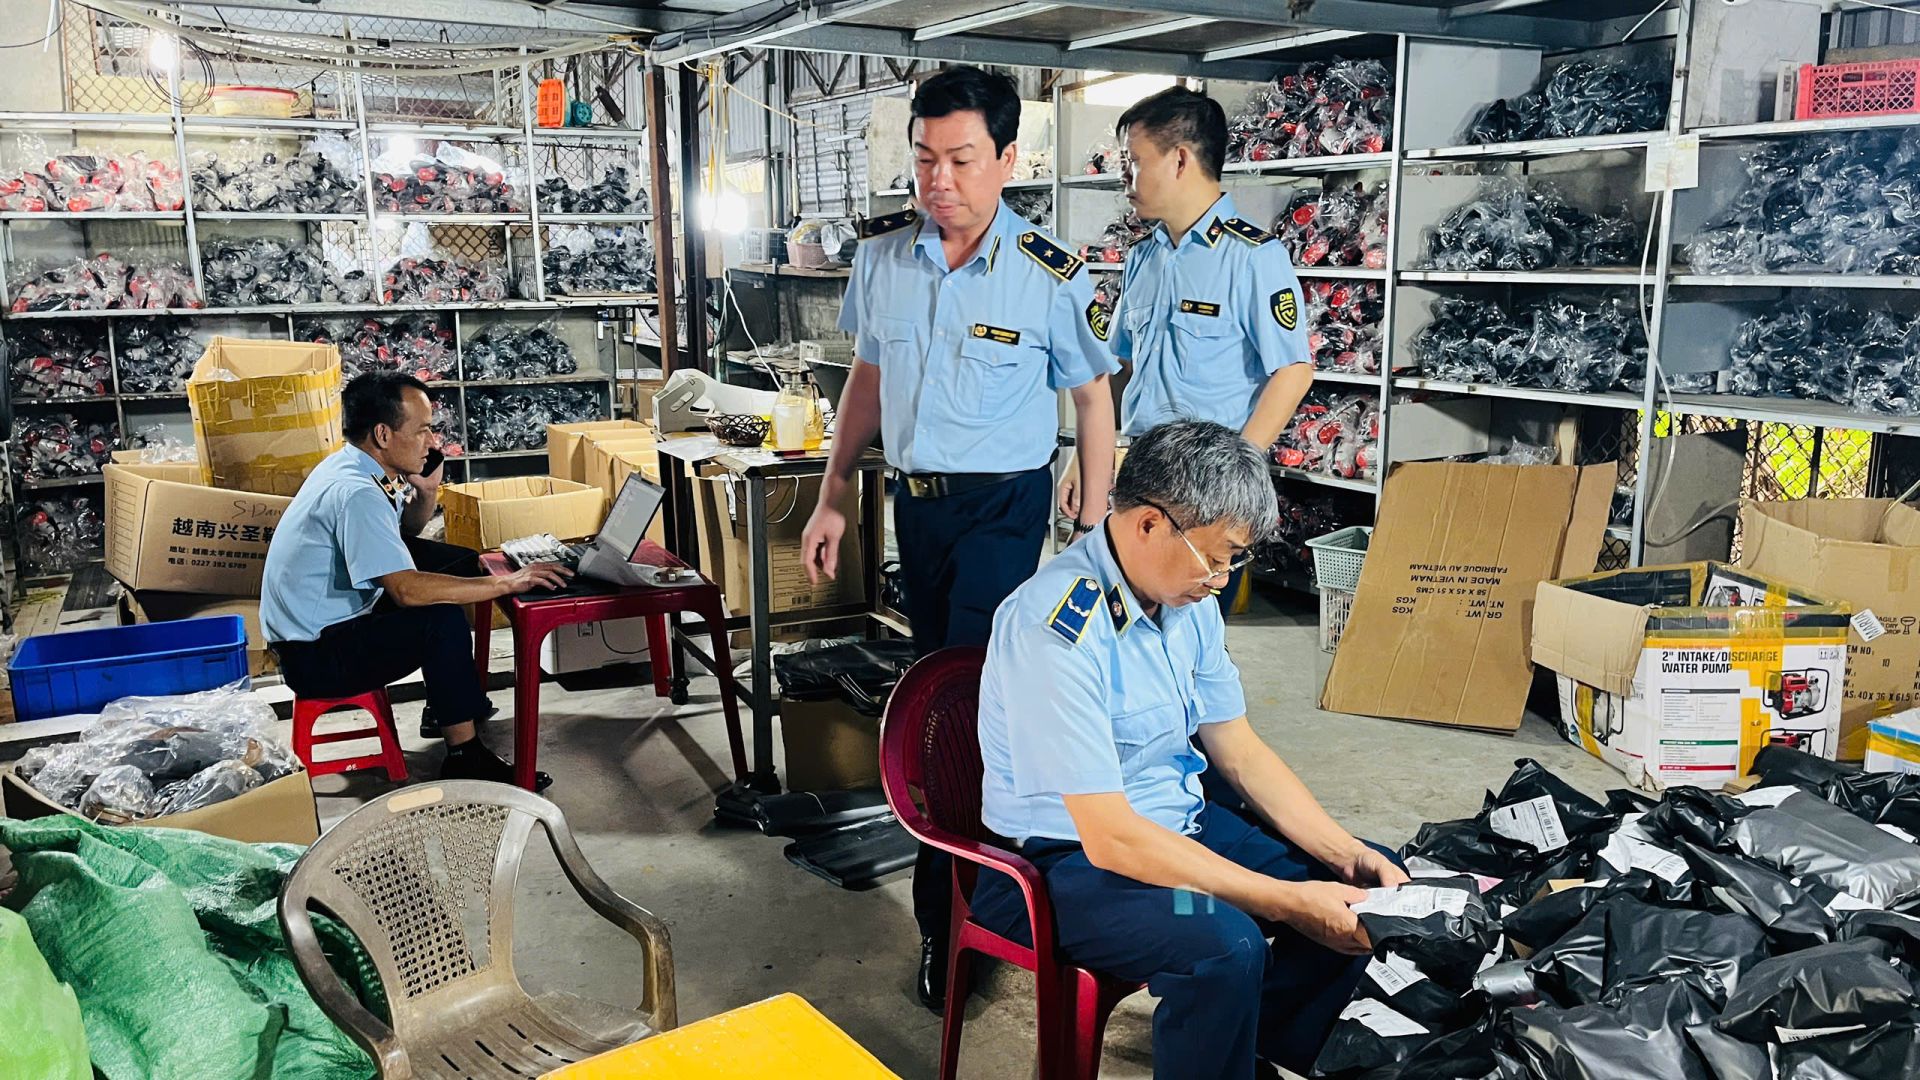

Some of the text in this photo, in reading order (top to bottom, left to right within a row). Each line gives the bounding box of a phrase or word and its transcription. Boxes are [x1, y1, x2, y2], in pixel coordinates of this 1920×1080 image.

[1409, 563, 1447, 572] VIETNAM
[1409, 574, 1501, 586] MADE IN VIETNAM
[1415, 586, 1434, 594] CMS
[1395, 596, 1417, 604] KGS
[1391, 606, 1414, 614] KGS
[1846, 644, 1858, 654] EM
[1678, 650, 1778, 662] INTAKE/DISCHARGE
[1661, 663, 1732, 674] WATER PUMP
